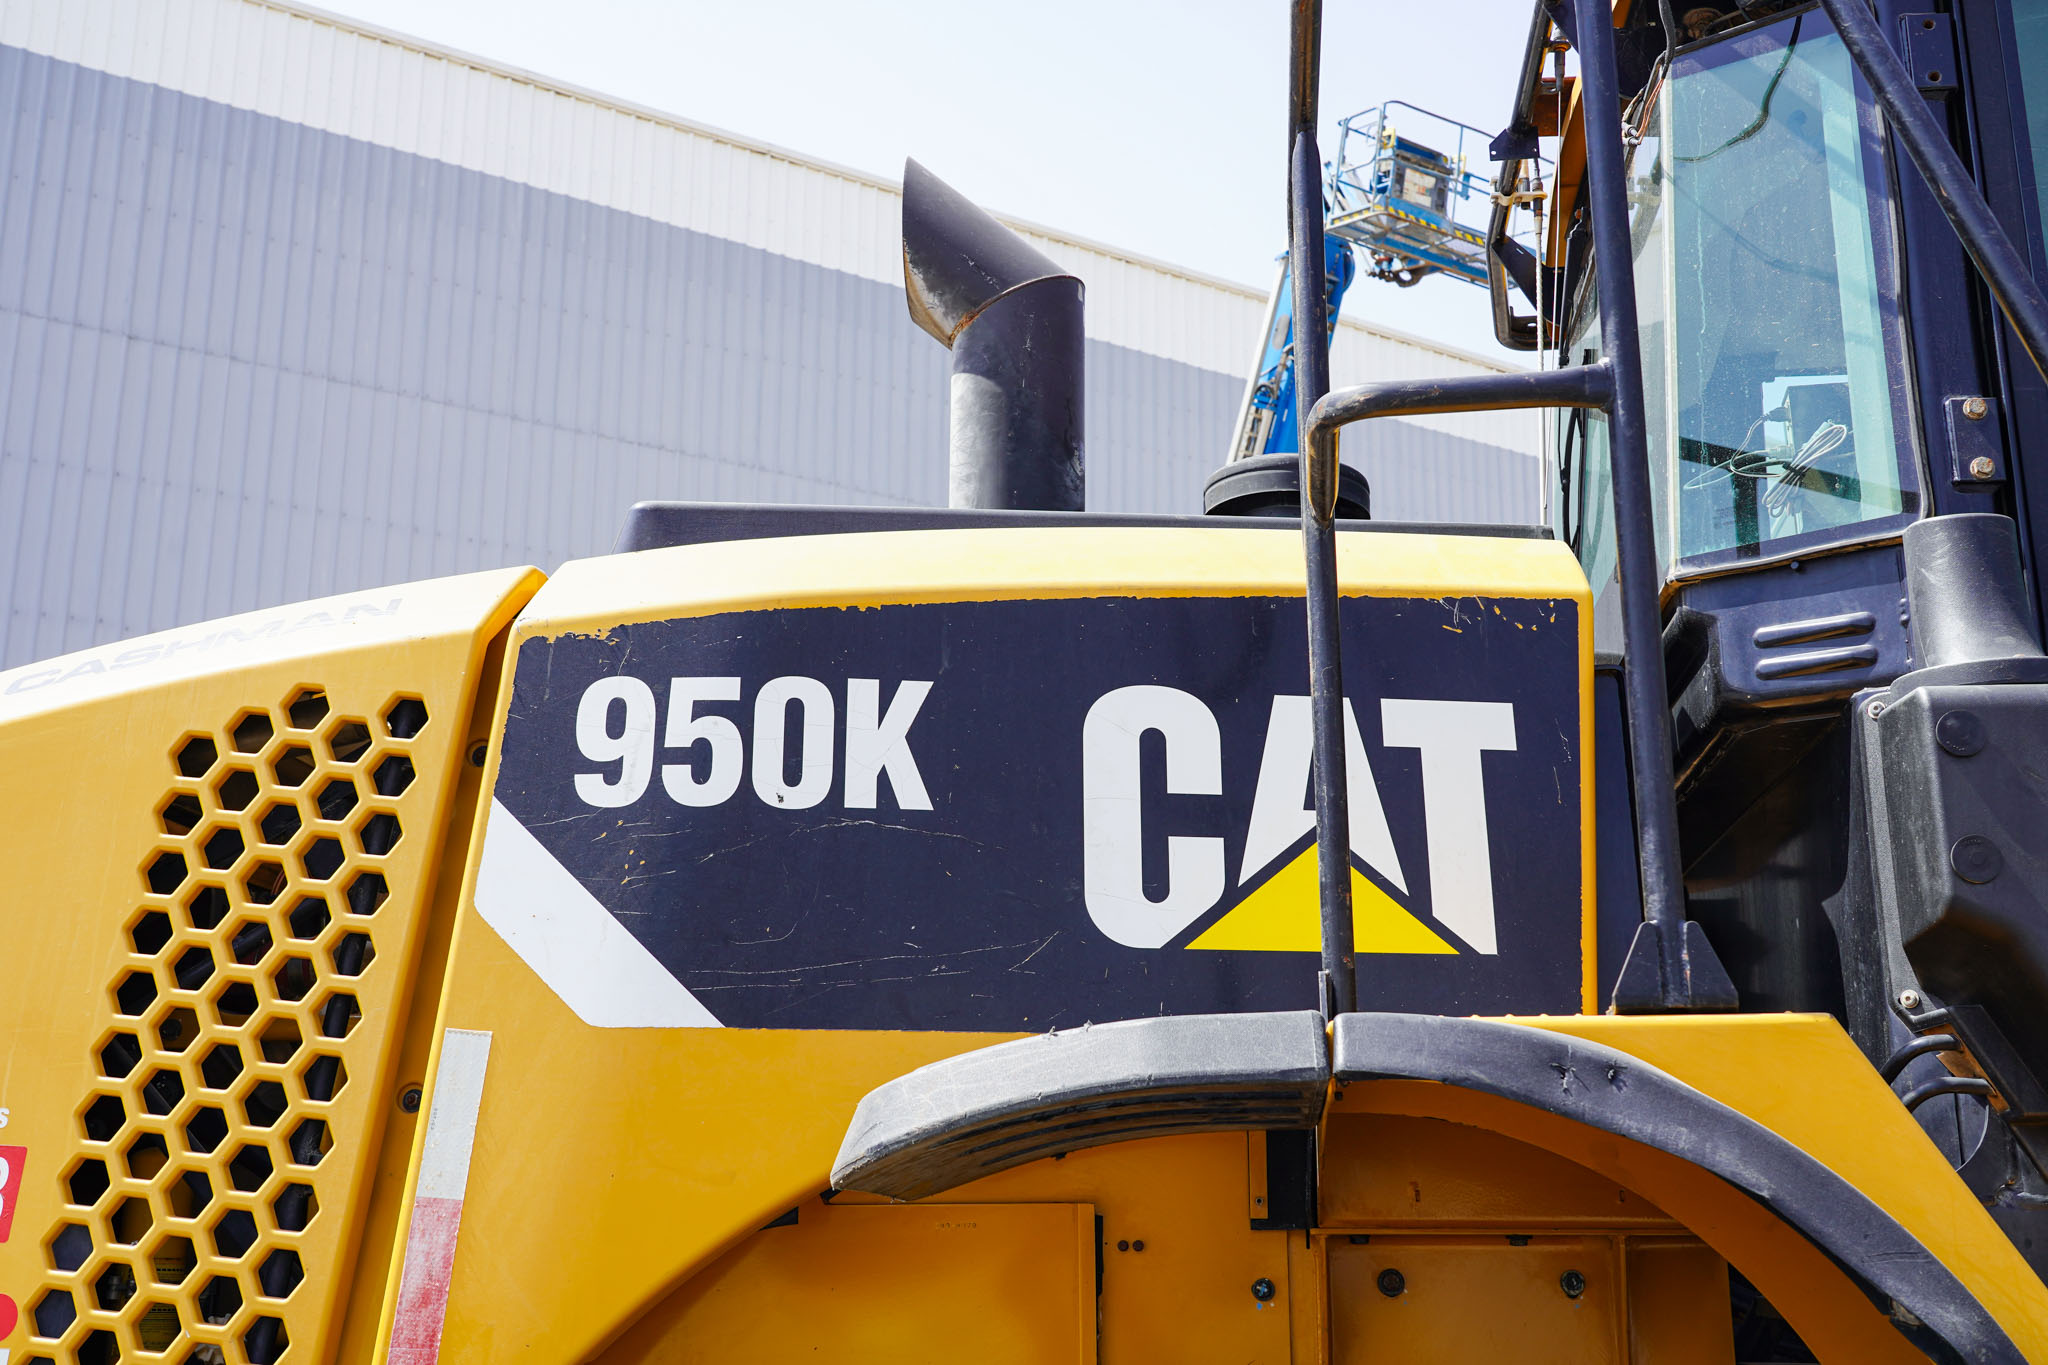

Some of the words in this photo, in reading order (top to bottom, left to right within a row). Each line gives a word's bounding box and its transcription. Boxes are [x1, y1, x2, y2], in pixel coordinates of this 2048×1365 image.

[4, 598, 403, 696] CASHMAN
[574, 675, 934, 811] 950K
[1083, 685, 1517, 955] CAT
